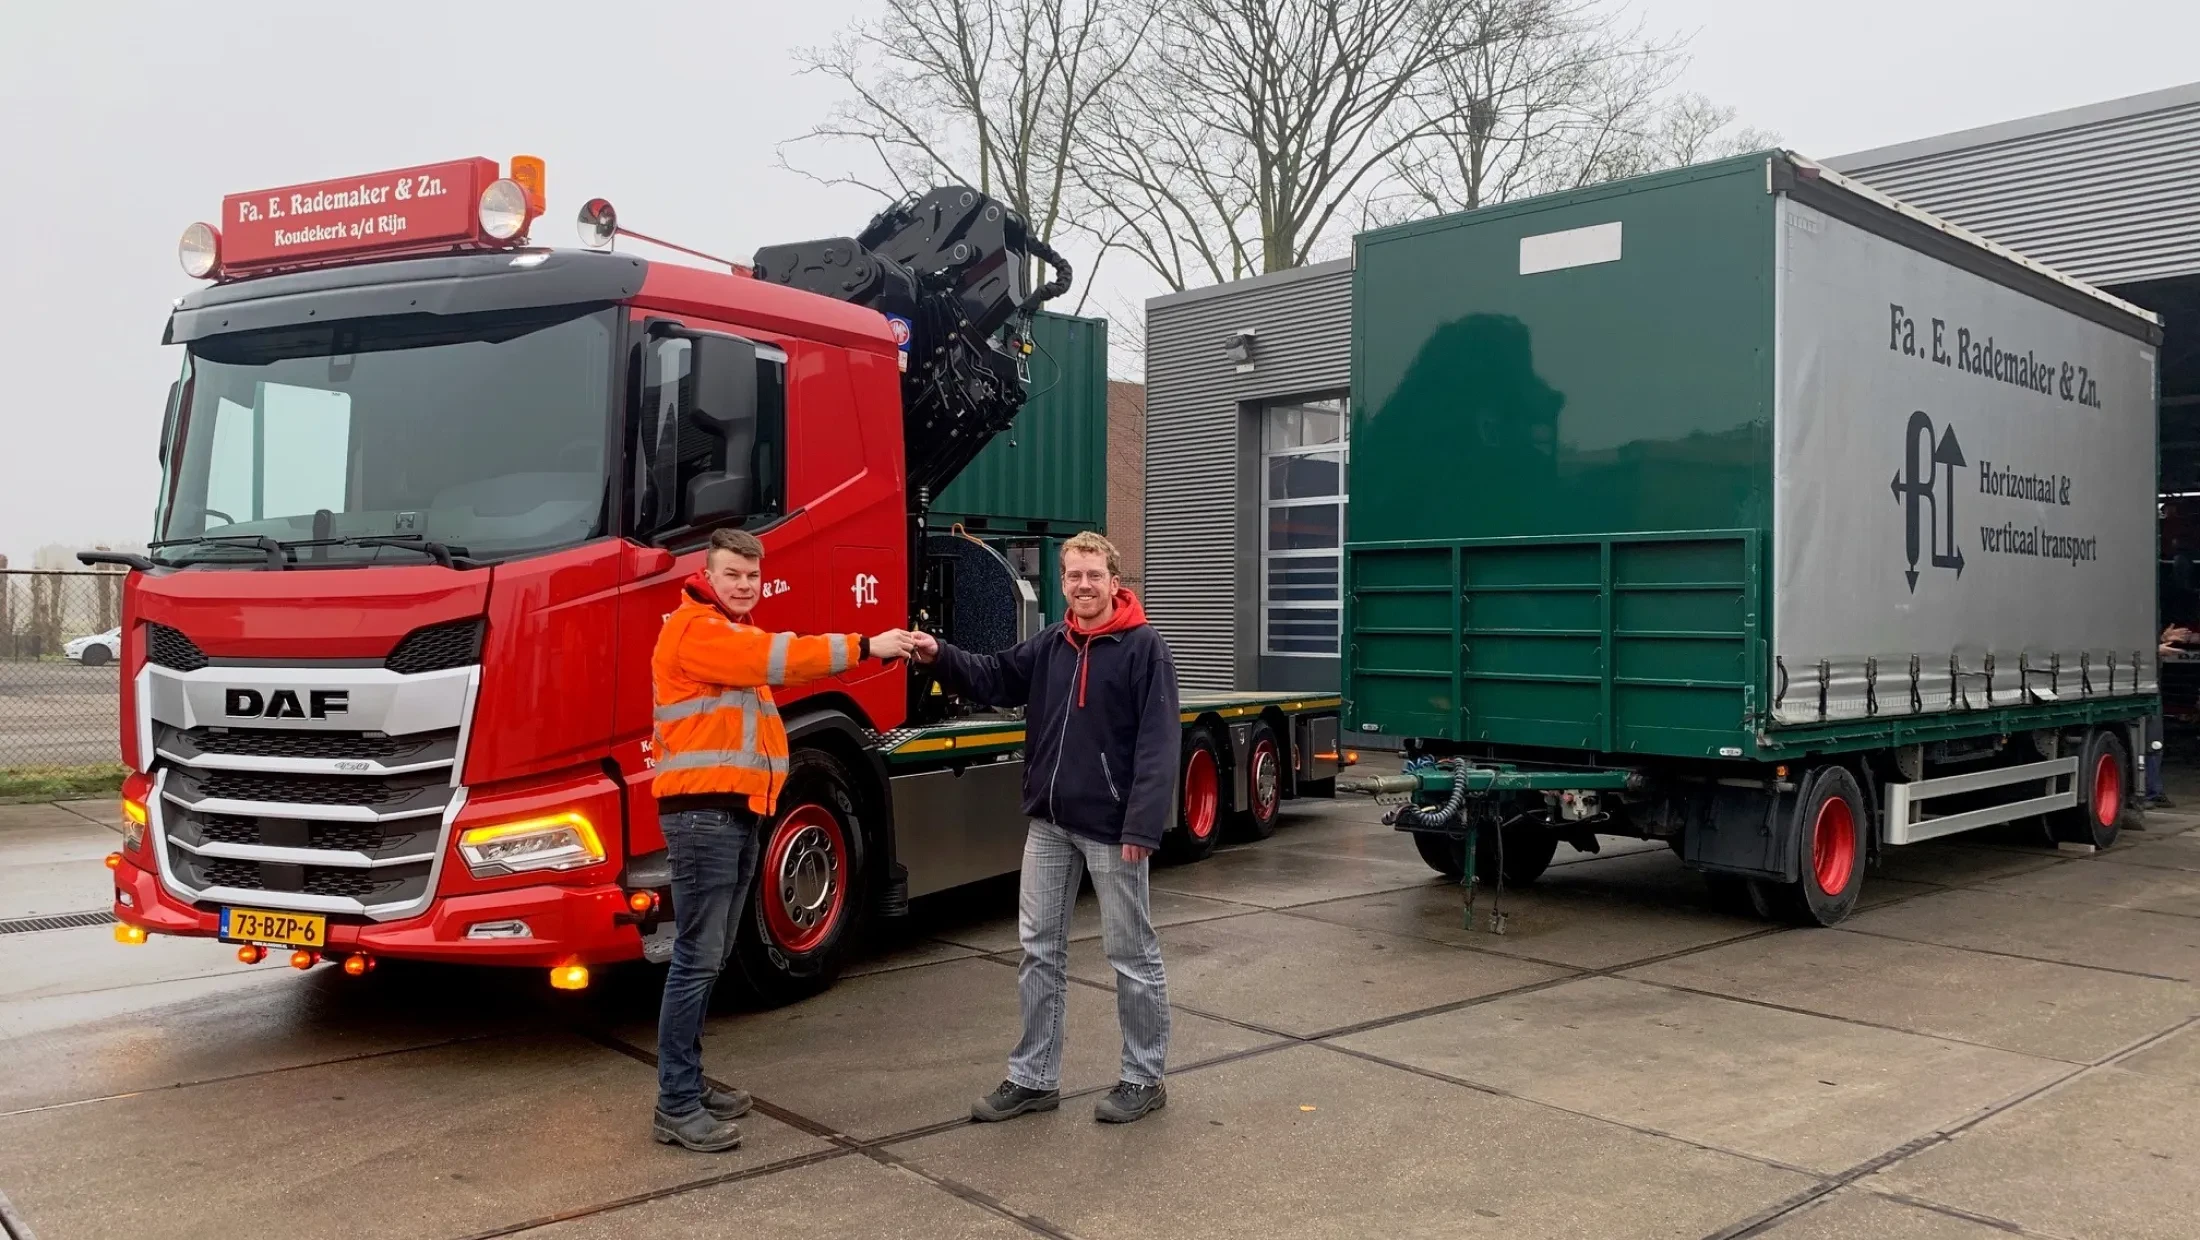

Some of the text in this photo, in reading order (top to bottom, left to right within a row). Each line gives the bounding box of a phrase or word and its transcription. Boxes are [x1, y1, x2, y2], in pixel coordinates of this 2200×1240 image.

[239, 175, 447, 222] Fa. E. Rademaker & Zn.
[274, 213, 406, 247] Koudekerk a/d Rijn
[1889, 302, 2101, 409] Fa. E. Rademaker & Zn.
[1979, 460, 2071, 506] Horizontaal &
[1980, 521, 2097, 567] verticaal transport
[762, 578, 790, 598] & Zn.
[224, 687, 350, 721] DAF
[237, 914, 315, 941] 73-BZP-6
